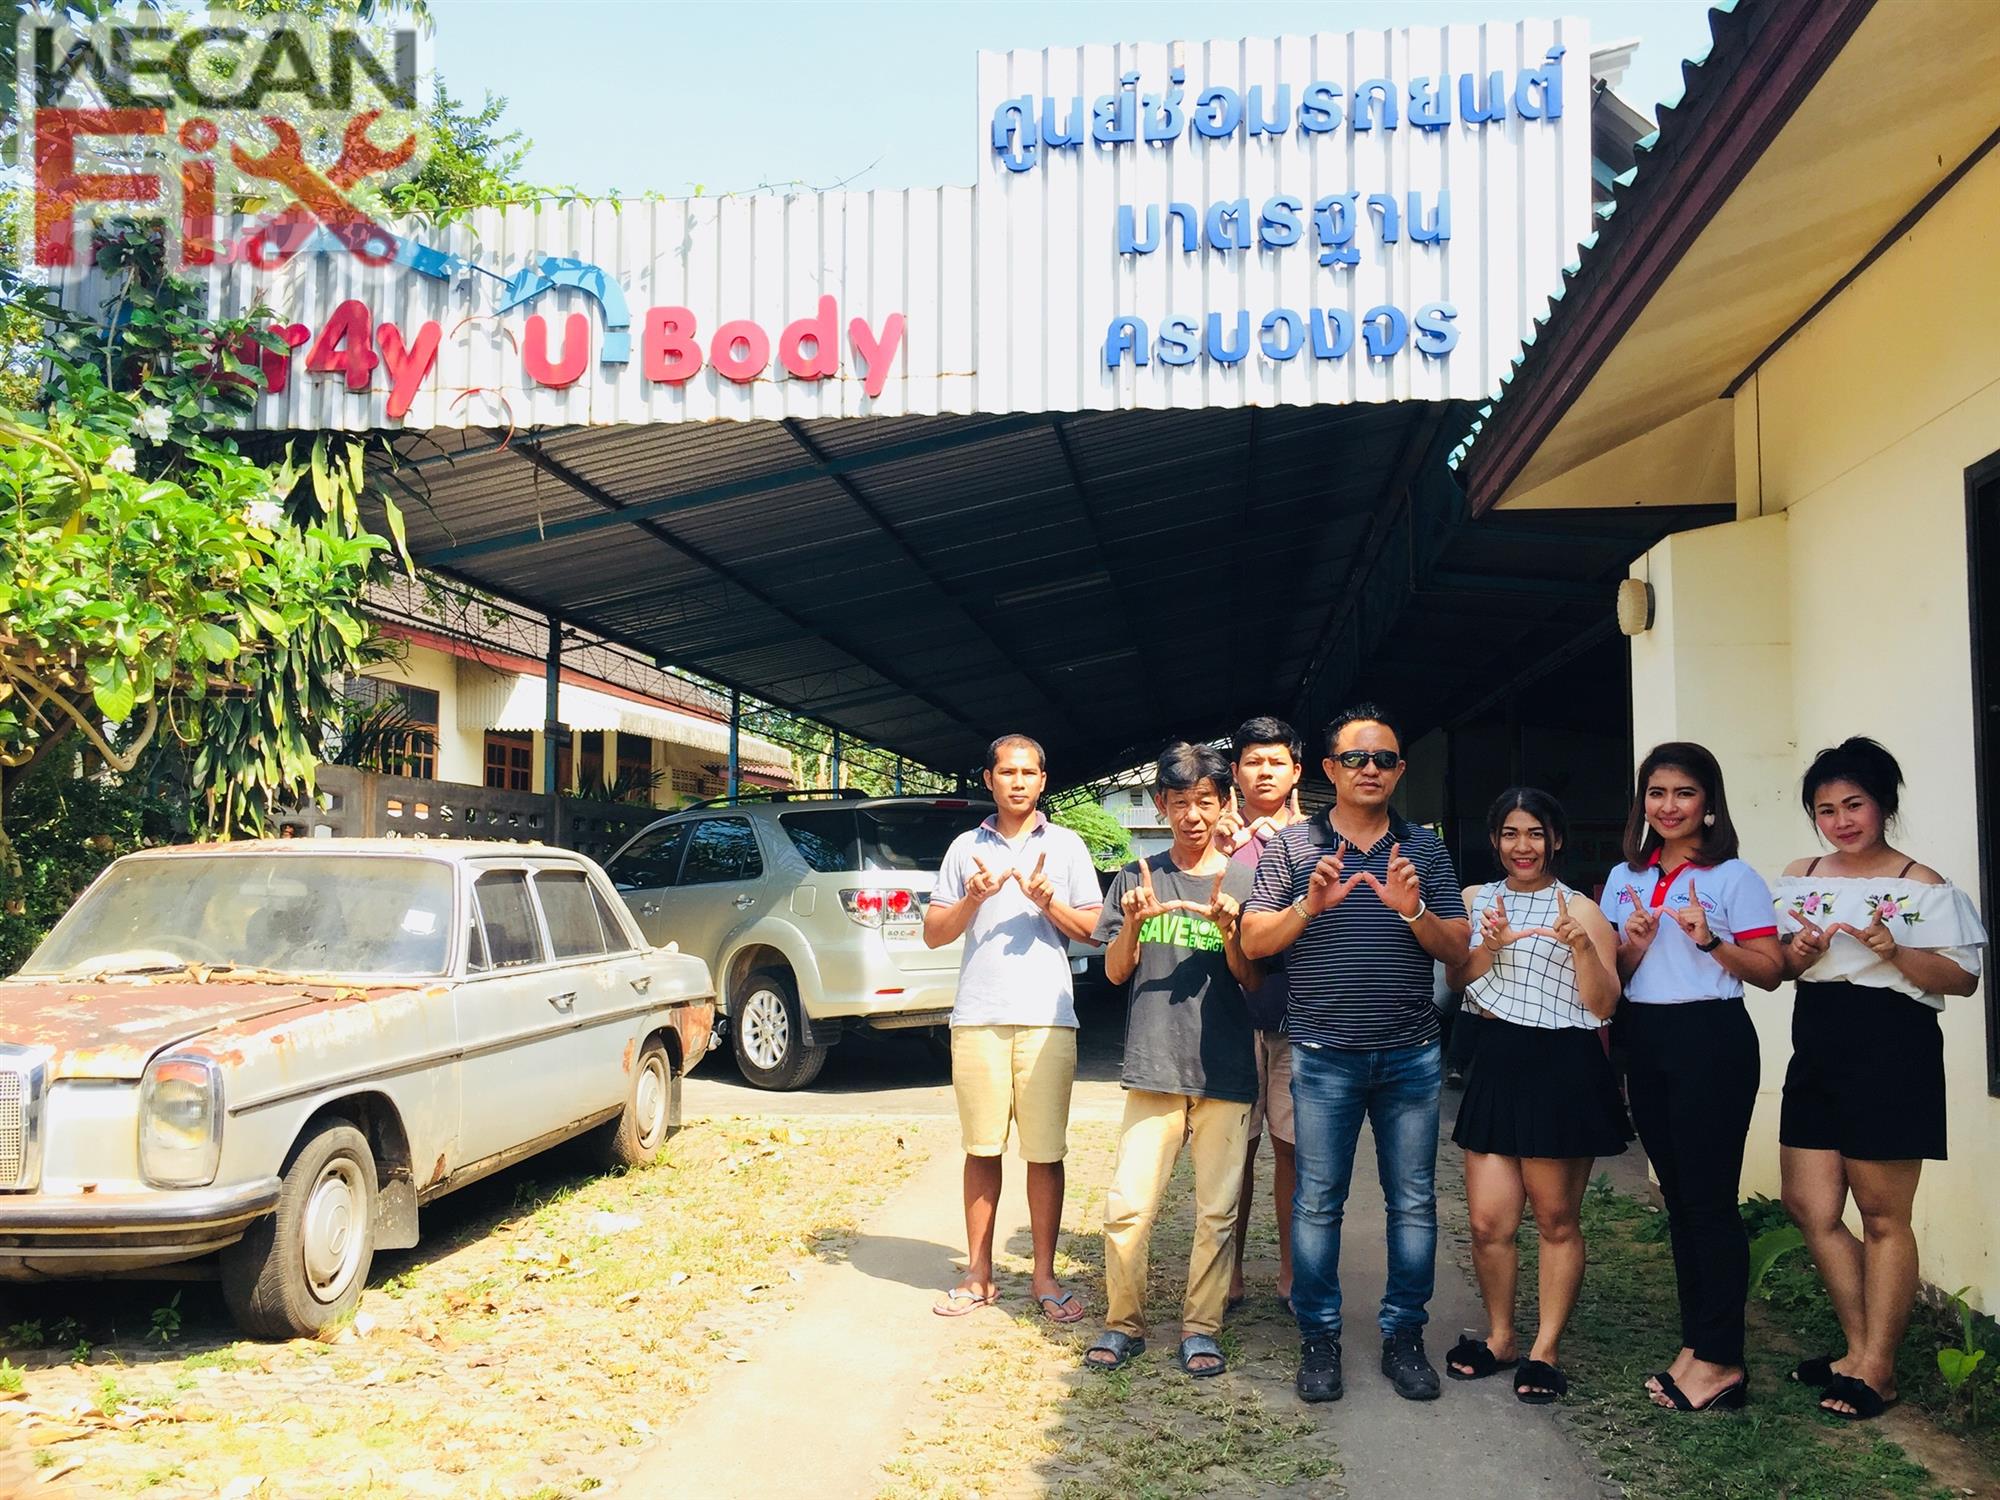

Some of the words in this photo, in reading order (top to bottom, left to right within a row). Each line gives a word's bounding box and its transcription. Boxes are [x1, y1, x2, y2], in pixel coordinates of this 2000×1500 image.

[992, 46, 1566, 172] ศูนย์ซ่อมรถยนต์
[1118, 190, 1452, 267] มาตรฐาน
[644, 295, 906, 398] Body
[1105, 302, 1459, 368] ครบวงจร
[1139, 913, 1192, 946] SAVE
[1189, 934, 1225, 953] ENERGY
